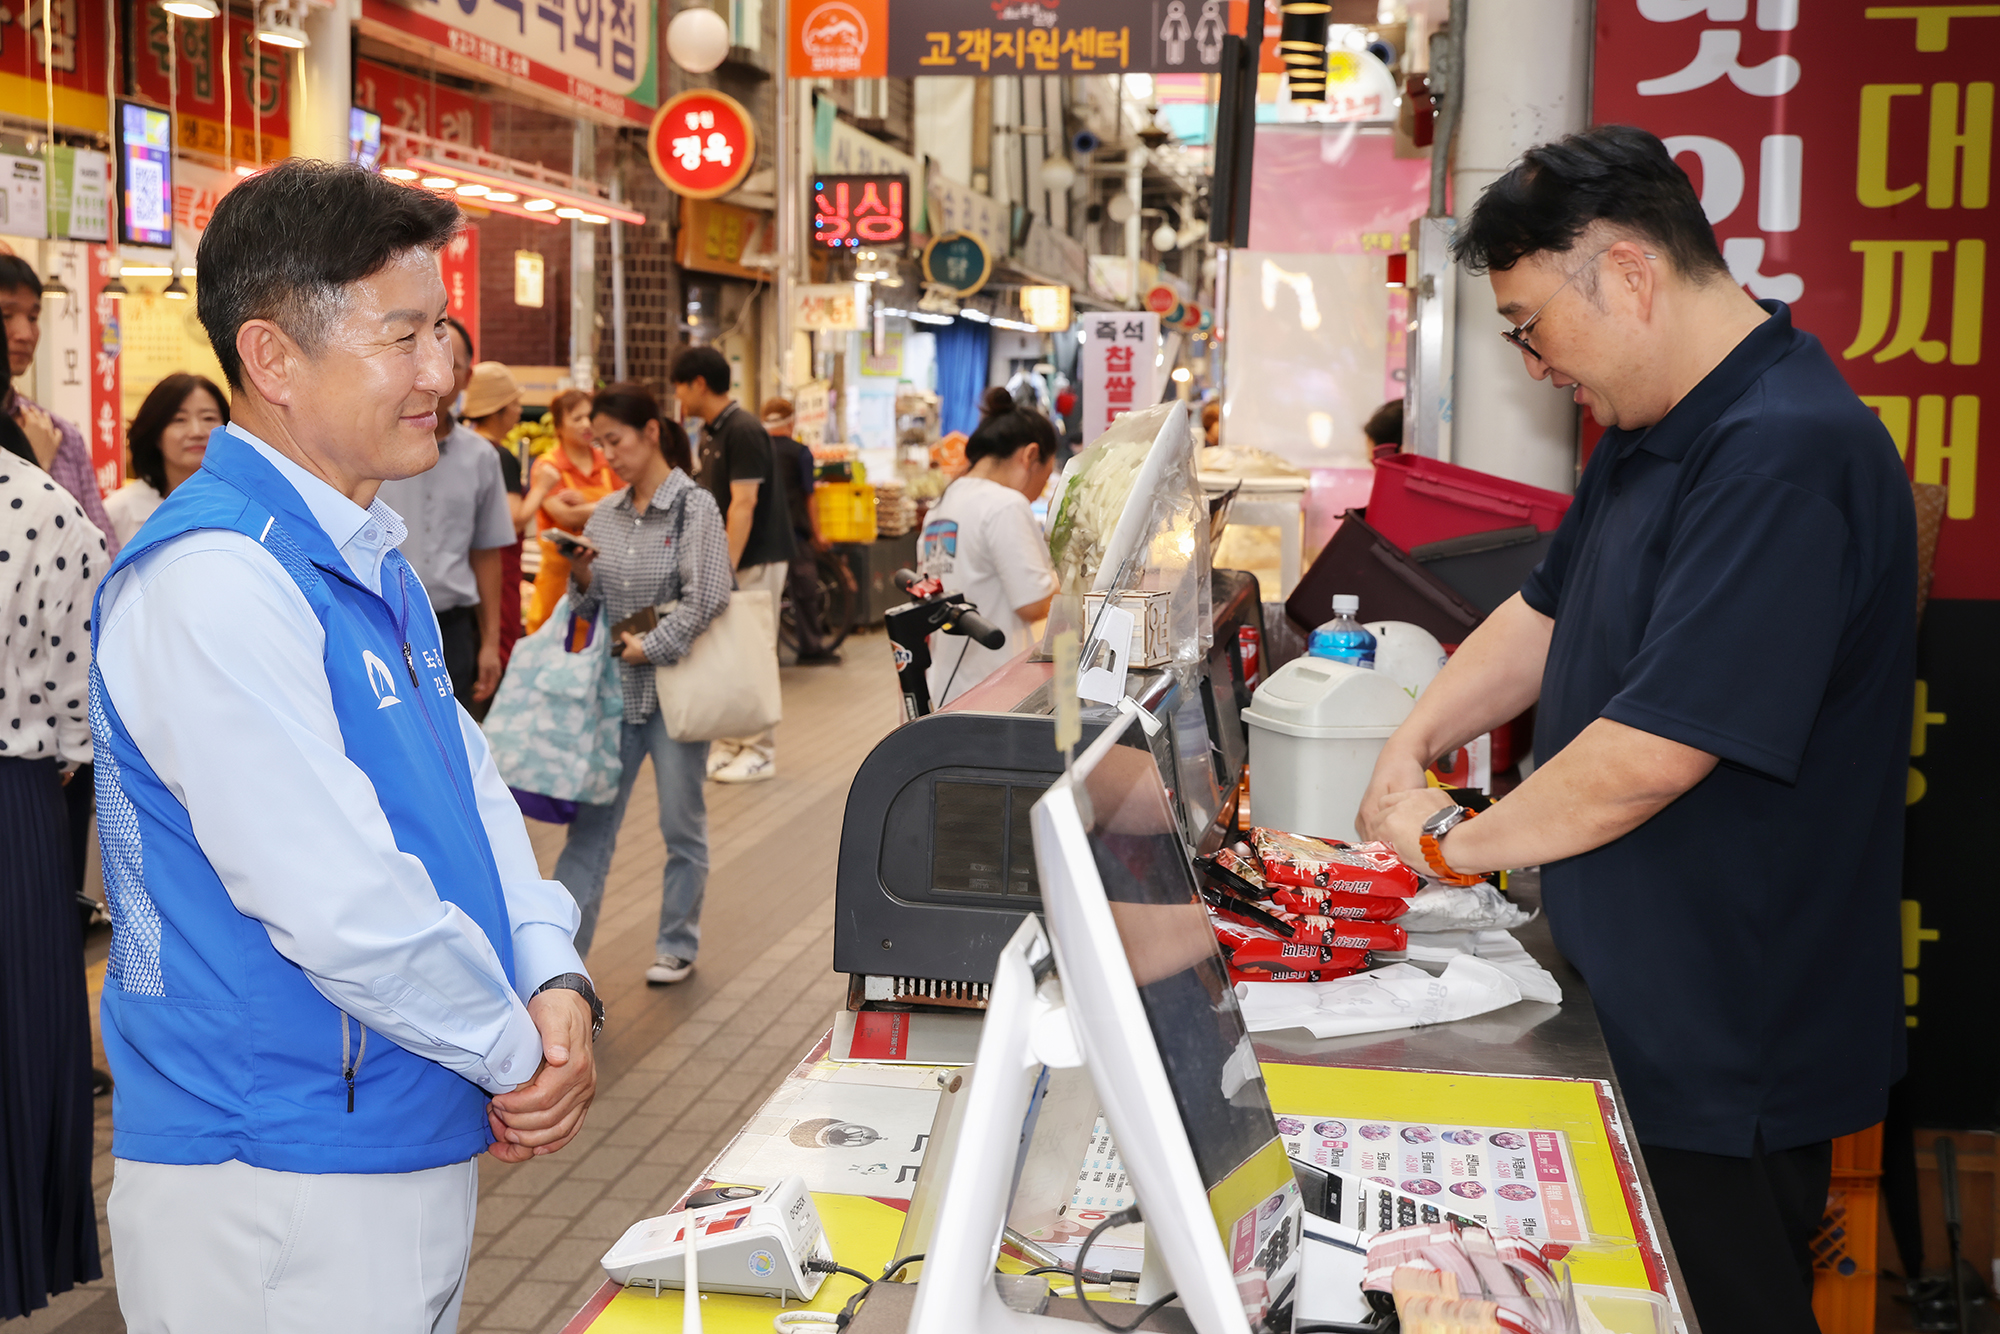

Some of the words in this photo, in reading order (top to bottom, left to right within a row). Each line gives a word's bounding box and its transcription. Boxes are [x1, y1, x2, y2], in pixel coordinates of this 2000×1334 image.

[918, 26, 1131, 73] 고객지원센터
[671, 131, 734, 171] 정육
[1094, 319, 1145, 343] 즉석
[1326, 879, 1373, 895] 사리면
